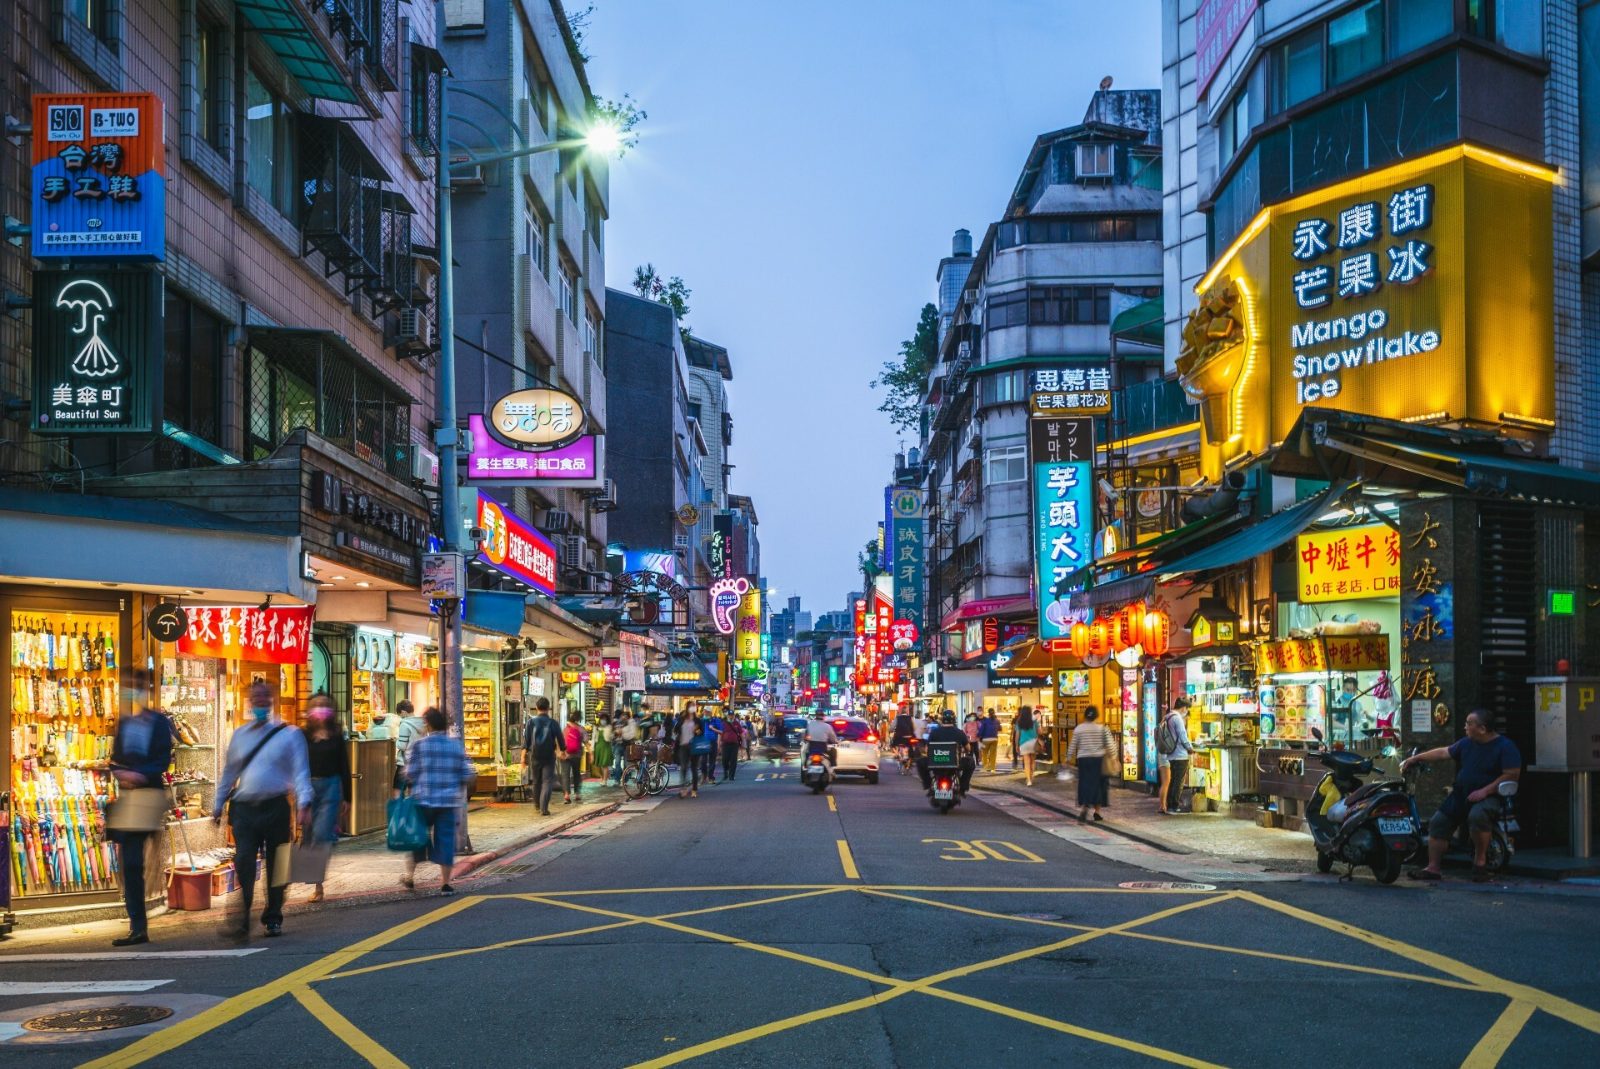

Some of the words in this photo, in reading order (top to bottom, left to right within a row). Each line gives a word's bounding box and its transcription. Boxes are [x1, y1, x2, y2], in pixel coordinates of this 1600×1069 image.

[51, 108, 81, 131] SO
[93, 112, 136, 127] B-TWO
[59, 145, 120, 169] 台灣
[43, 175, 138, 200] 手工鞋
[1293, 184, 1429, 259] 永康街
[1294, 241, 1427, 308] 芒果冰
[1291, 309, 1387, 348] Mango
[1292, 331, 1440, 378] Snowflake
[52, 384, 122, 406] 美傘町
[1297, 379, 1340, 404] Ice
[55, 410, 99, 419] Beautiful
[104, 410, 120, 419] Sun
[1301, 531, 1400, 575] 中壢牛家
[1540, 688, 1562, 712] P
[1578, 687, 1595, 711] P
[921, 838, 1047, 863] 30
